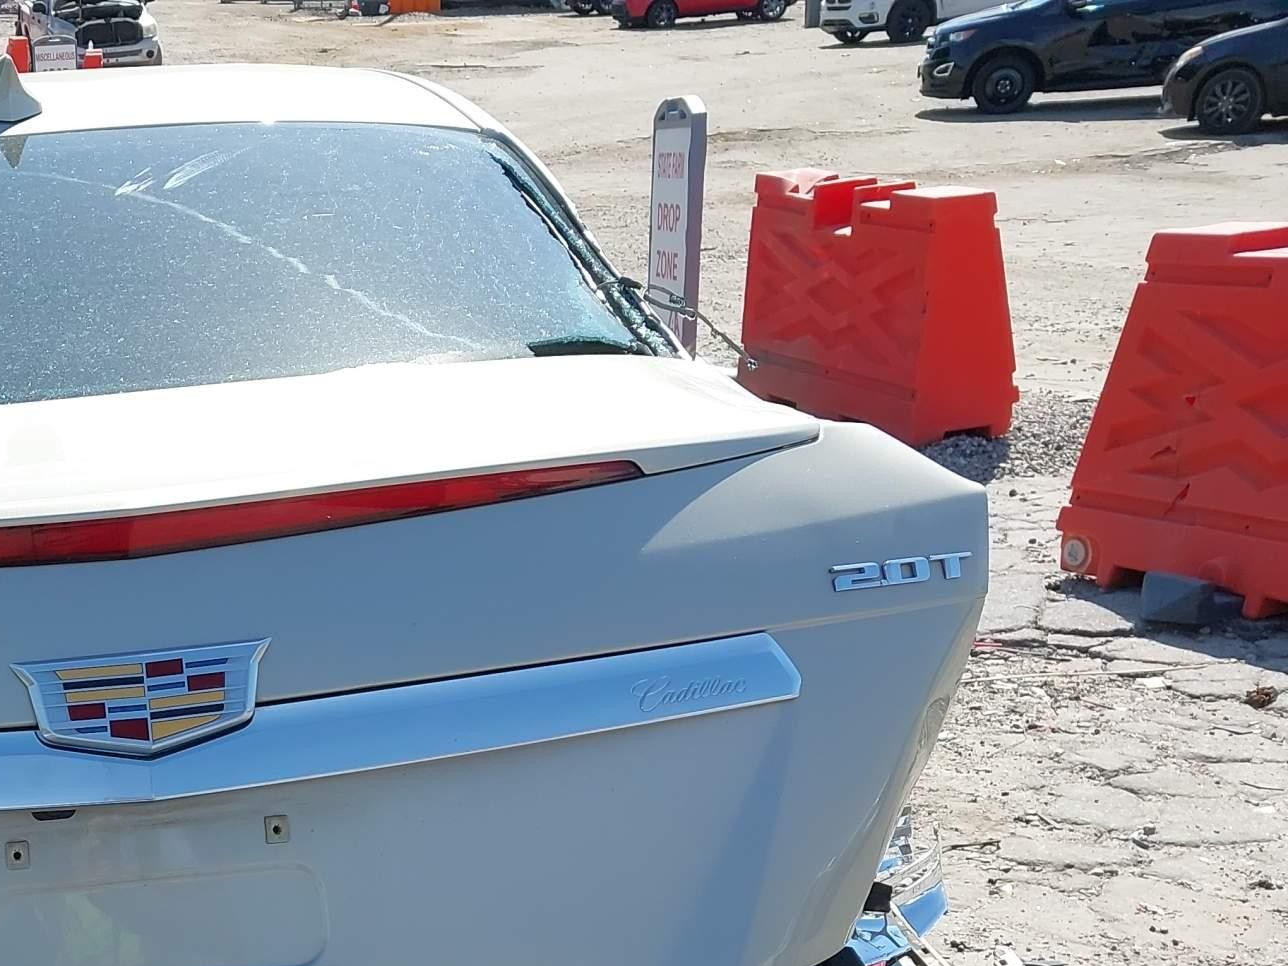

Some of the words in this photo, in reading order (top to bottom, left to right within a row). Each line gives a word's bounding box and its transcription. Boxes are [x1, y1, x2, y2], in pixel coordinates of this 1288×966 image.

[657, 203, 681, 233] DROP
[656, 250, 678, 281] ZONE
[630, 675, 748, 713] Cadillac
